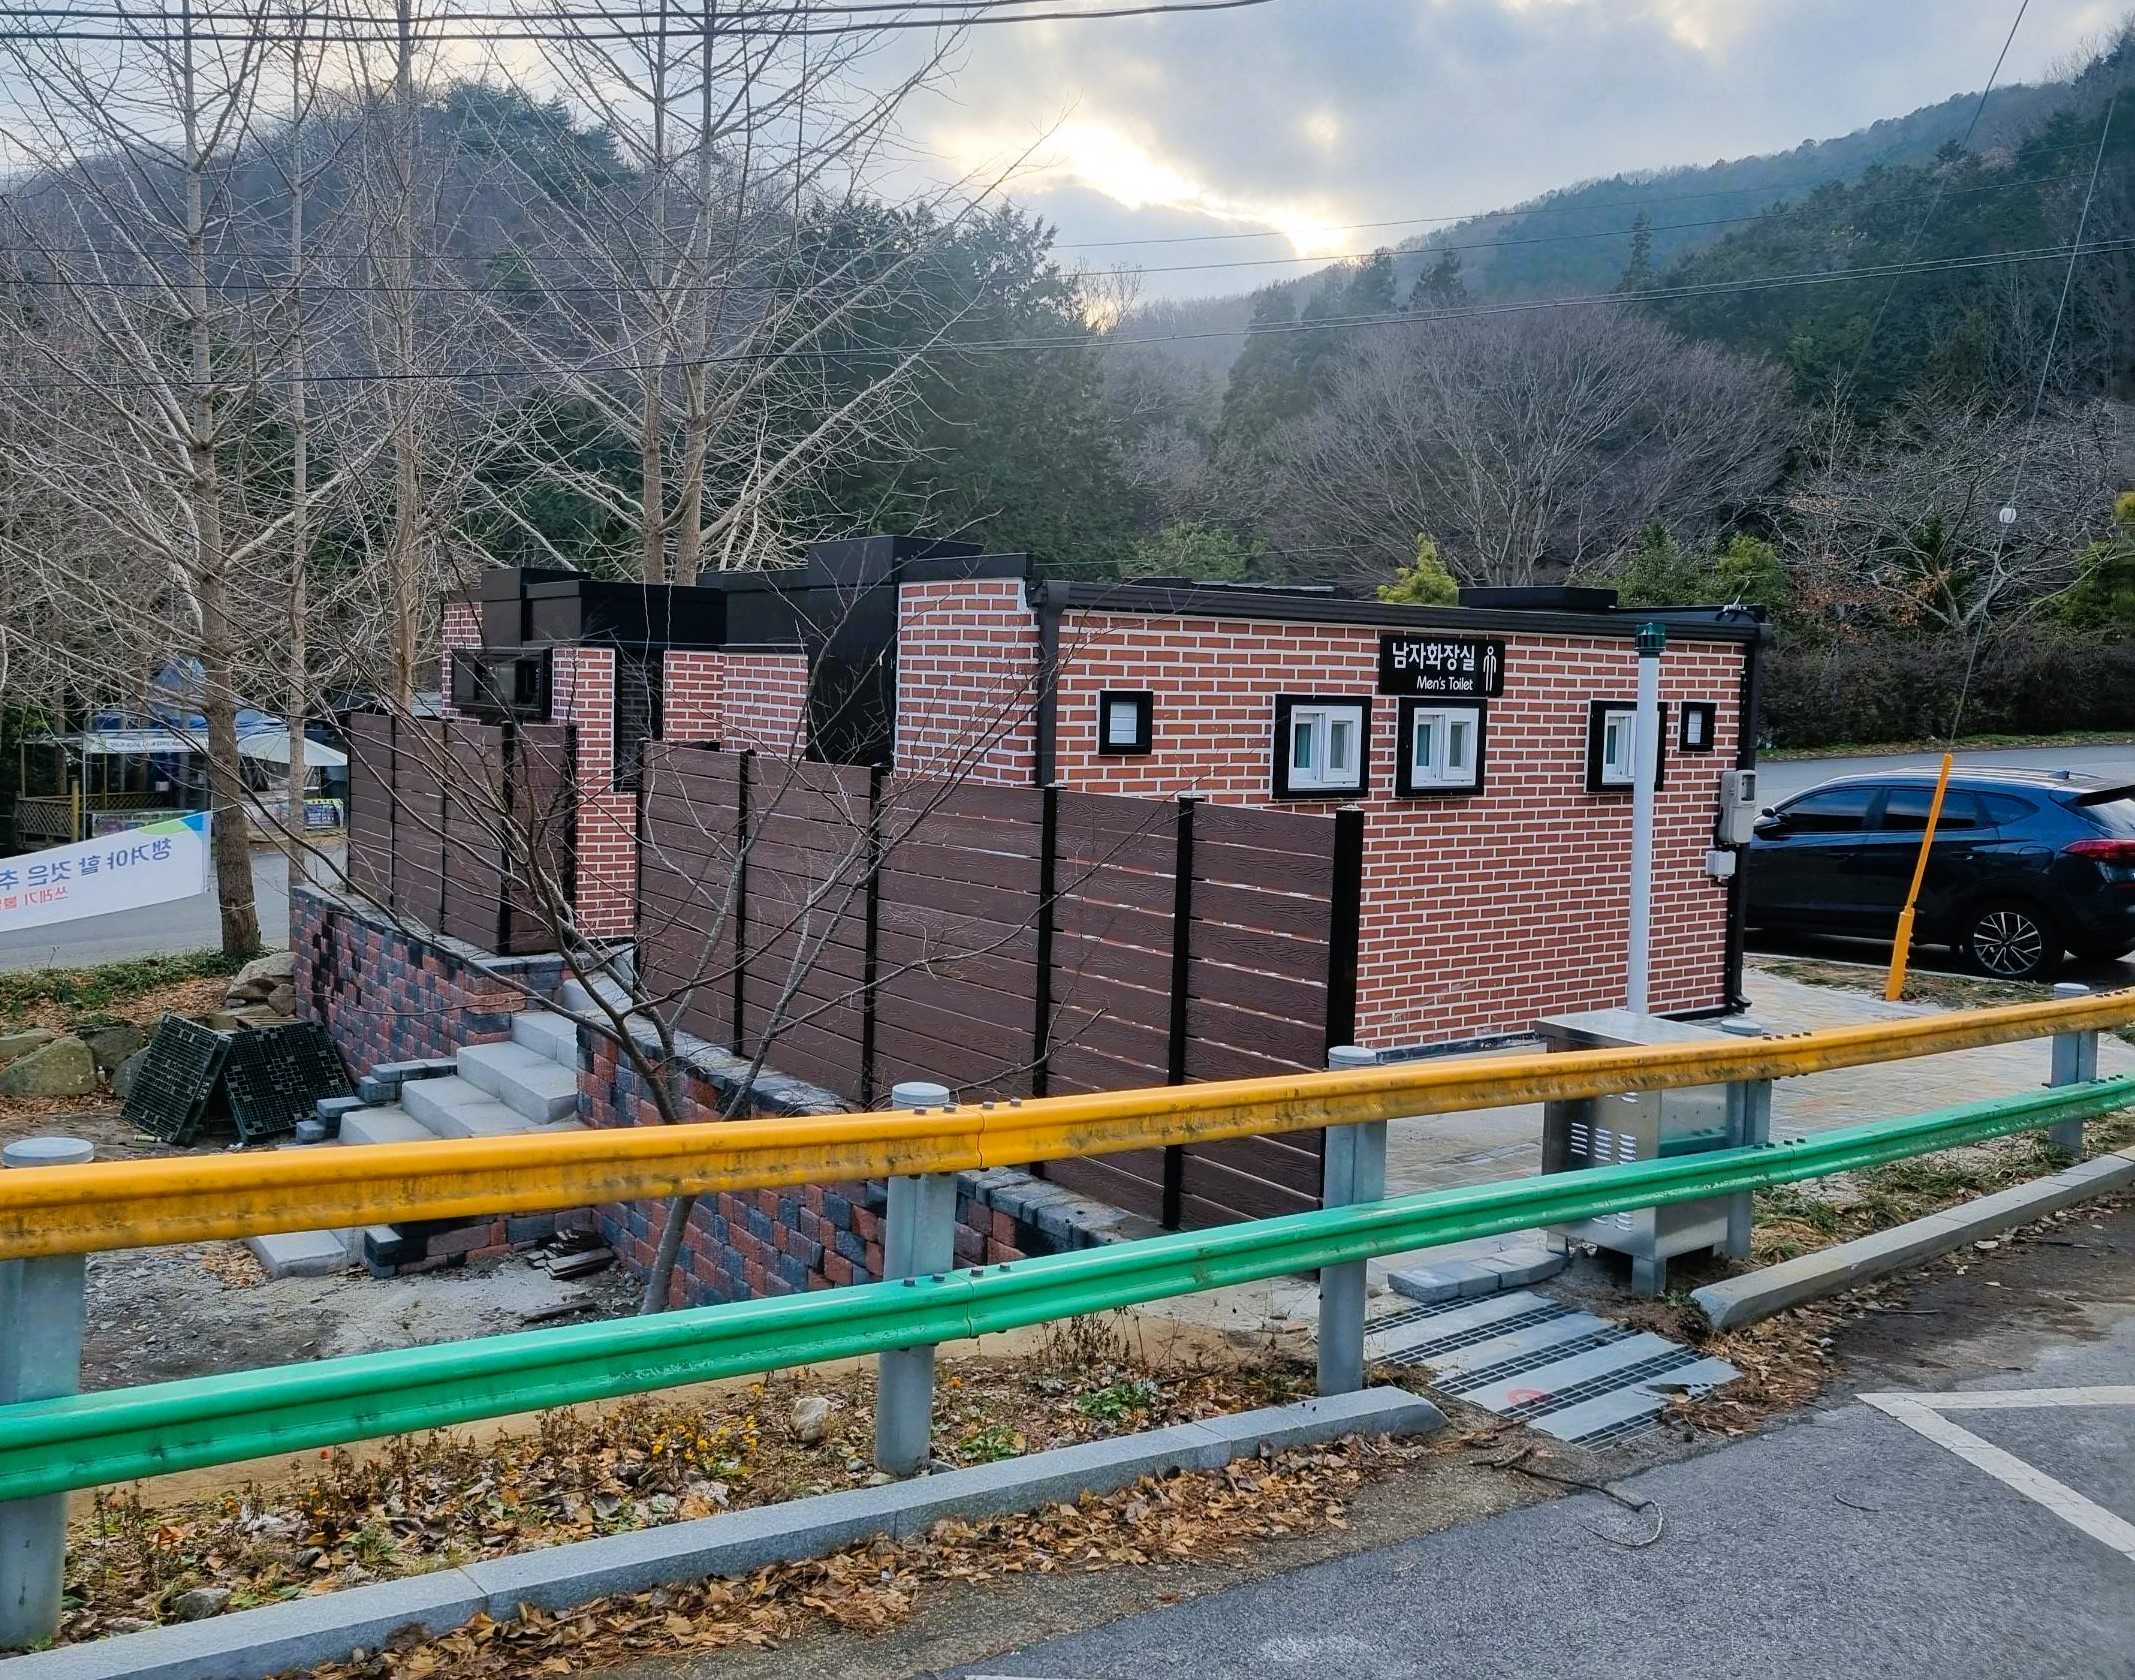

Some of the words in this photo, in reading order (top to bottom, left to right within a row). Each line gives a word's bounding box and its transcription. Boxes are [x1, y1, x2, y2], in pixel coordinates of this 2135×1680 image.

[1392, 642, 1475, 672] 남자화장실
[1416, 675, 1446, 690] Men's
[1449, 676, 1474, 691] Toilet
